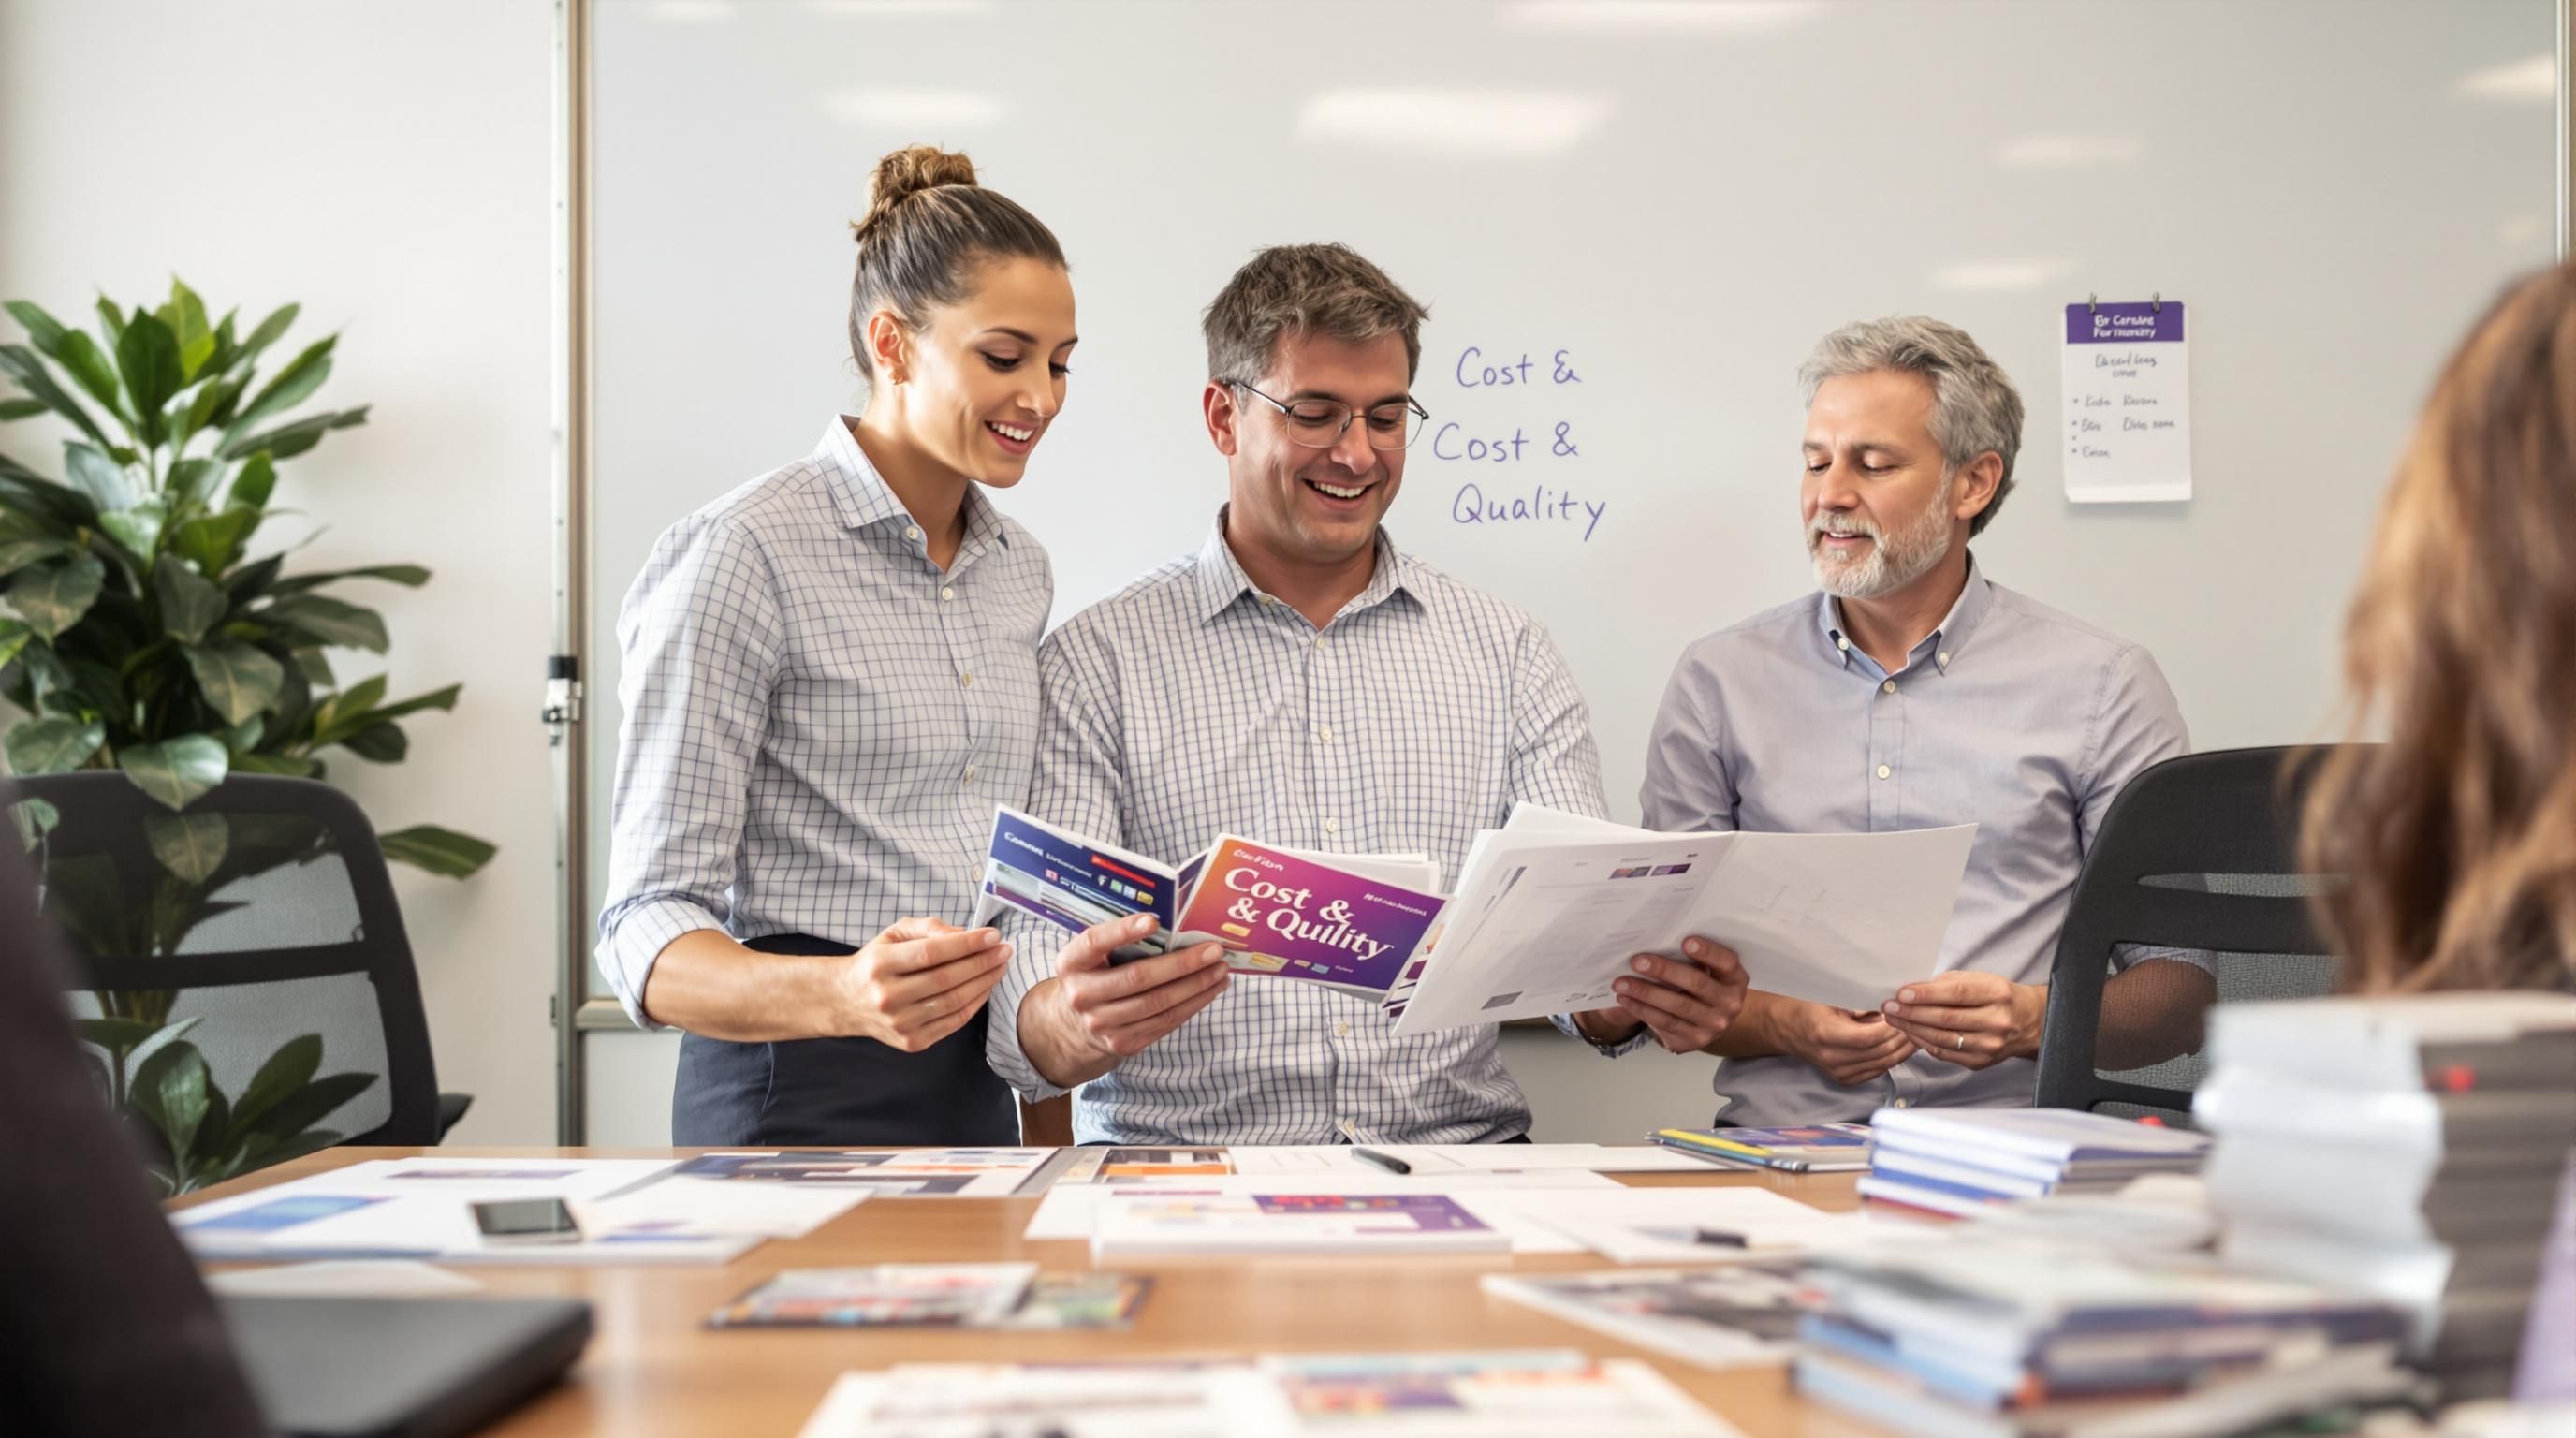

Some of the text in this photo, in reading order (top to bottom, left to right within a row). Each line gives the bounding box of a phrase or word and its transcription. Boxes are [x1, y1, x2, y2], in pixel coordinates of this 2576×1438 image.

[1456, 346, 1582, 388] Cost &
[1433, 421, 1579, 462] Cost &
[1453, 483, 1606, 542] Quality
[1224, 867, 1312, 910] Cost
[1319, 899, 1355, 924] &
[1227, 897, 1261, 923] &
